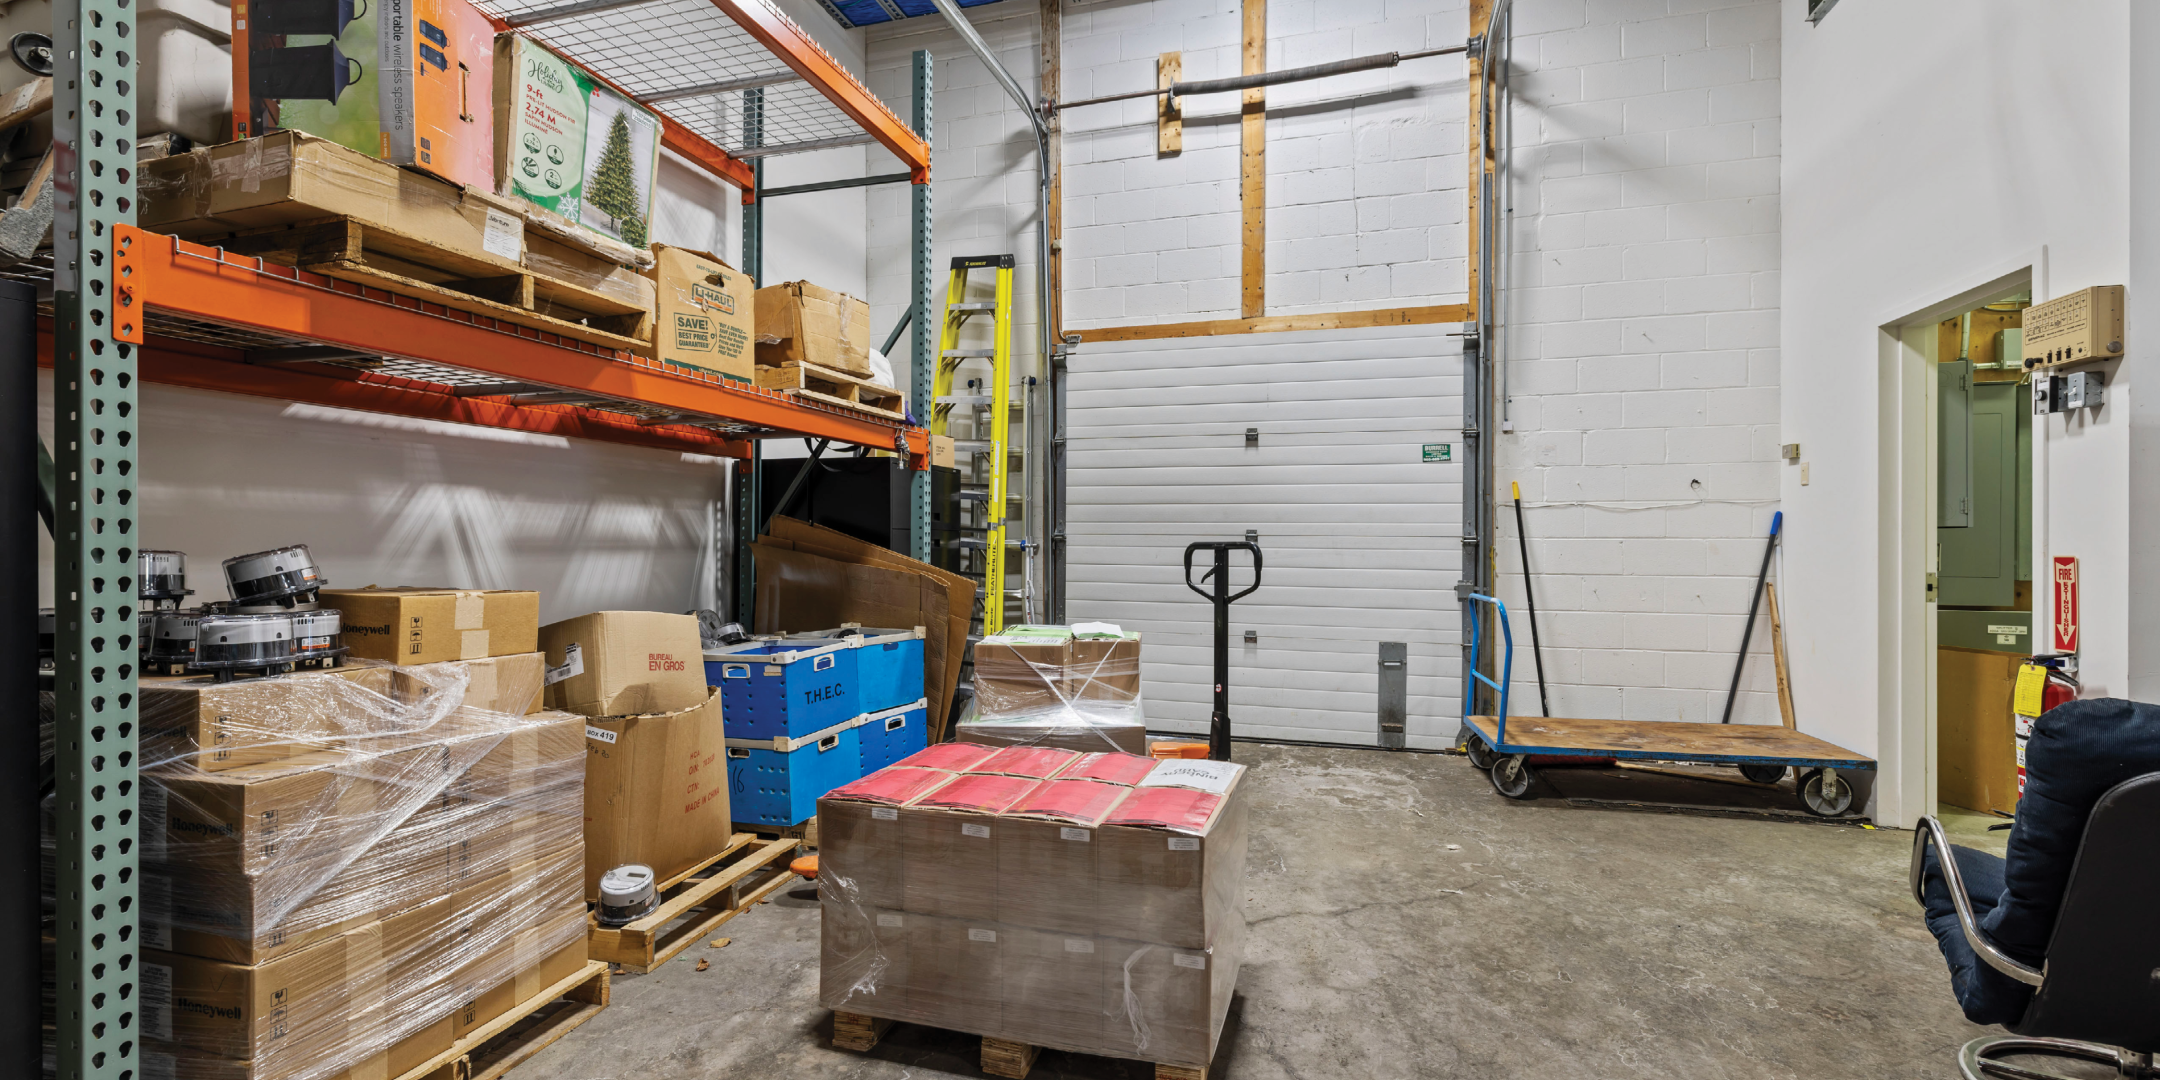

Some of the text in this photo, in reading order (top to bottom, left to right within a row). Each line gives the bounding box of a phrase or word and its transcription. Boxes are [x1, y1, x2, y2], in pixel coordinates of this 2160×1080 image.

[392, 0, 406, 131] portable wireless speakers
[528, 58, 564, 94] Holiday
[526, 84, 543, 100] 9-ft
[546, 114, 556, 124] M
[695, 287, 732, 308] U-HAUL
[678, 316, 708, 330] SAVE!
[678, 332, 708, 342] BEST PRICE
[2058, 568, 2072, 580] FIRE
[648, 661, 685, 671] EN GROS
[804, 683, 845, 705] T.H.E.C.
[587, 729, 614, 740] BOX 419
[587, 742, 599, 754] Feb
[684, 786, 720, 814] MADE IN CHINA
[172, 817, 233, 836] Honeywell
[178, 997, 242, 1020] Honeywell
